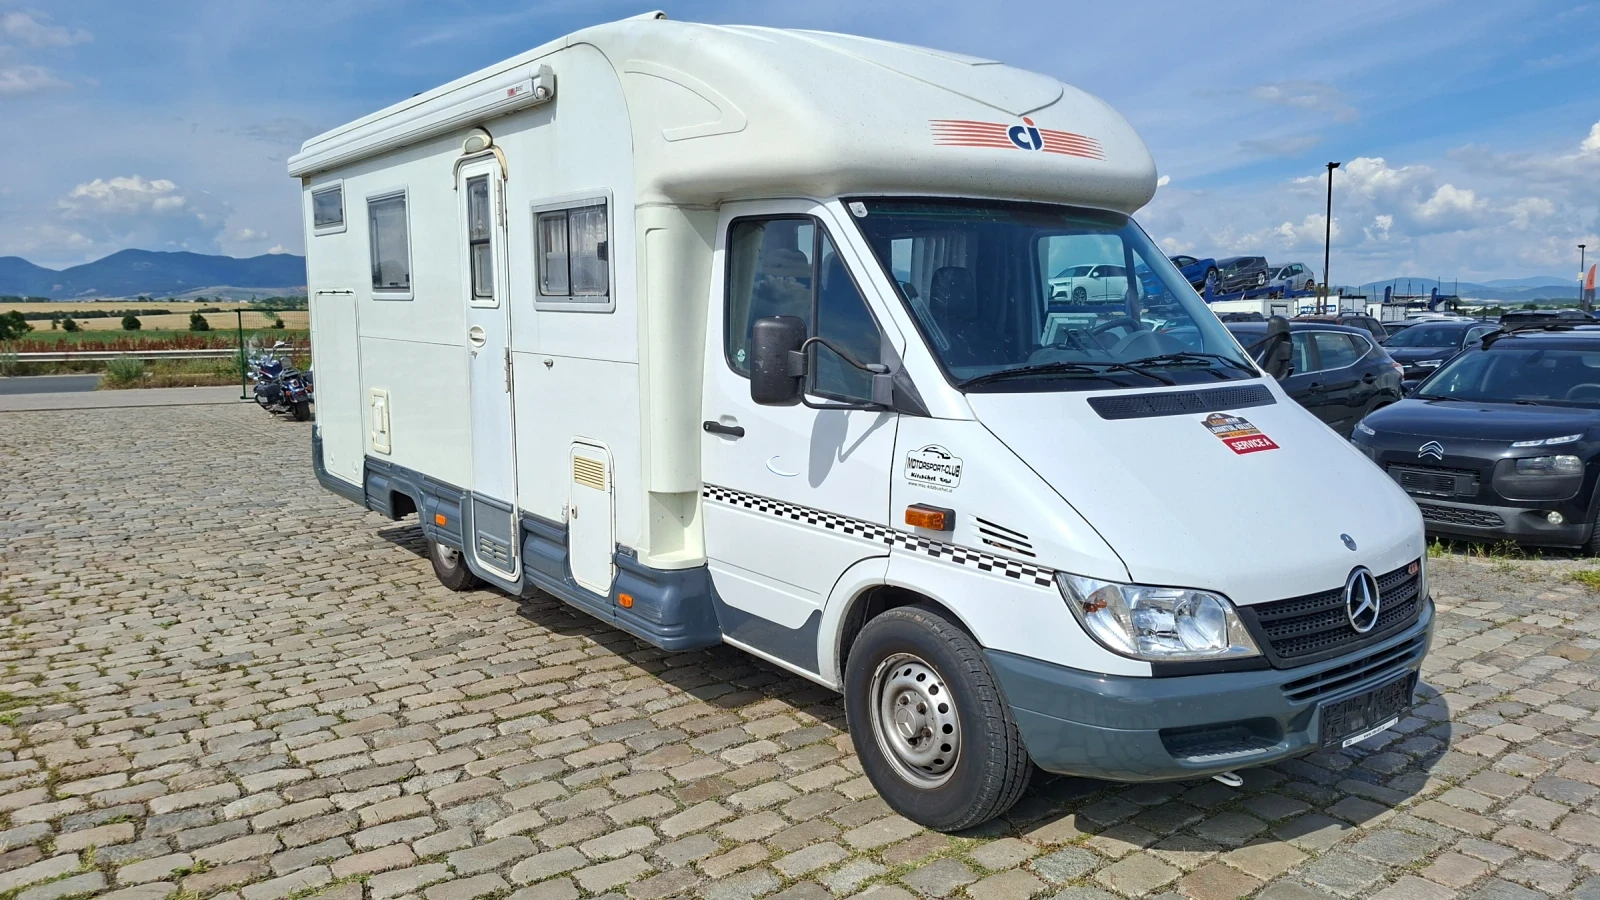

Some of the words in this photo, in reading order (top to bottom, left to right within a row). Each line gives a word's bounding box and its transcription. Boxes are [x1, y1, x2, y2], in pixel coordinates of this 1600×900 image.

[1231, 440, 1266, 450] SERVICE
[1263, 438, 1272, 446] A
[907, 457, 960, 478] MOTORSPORT-CLUB
